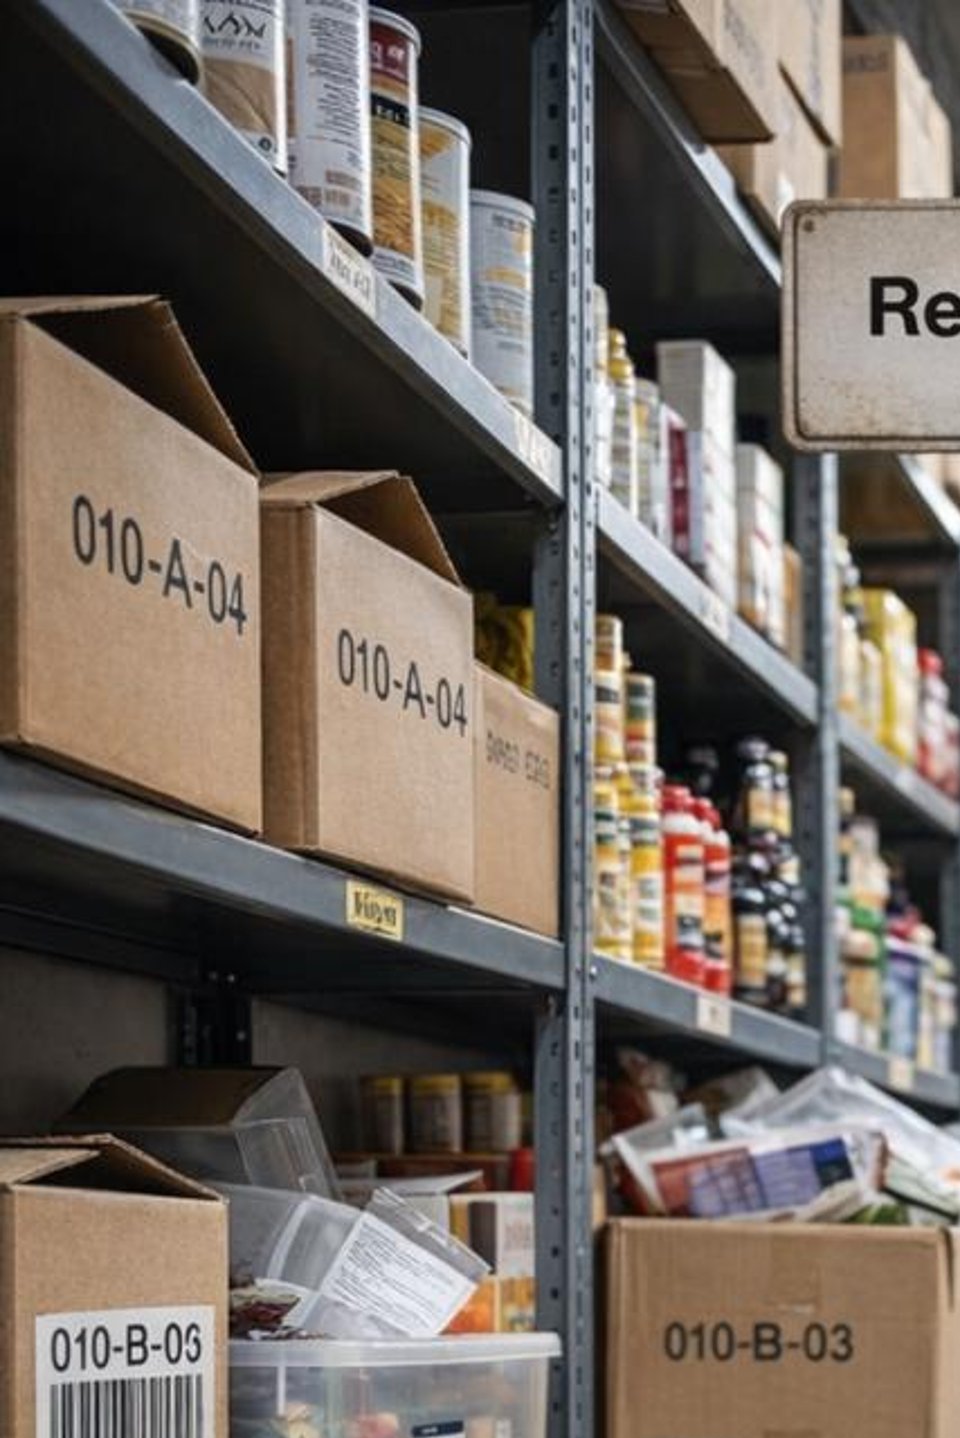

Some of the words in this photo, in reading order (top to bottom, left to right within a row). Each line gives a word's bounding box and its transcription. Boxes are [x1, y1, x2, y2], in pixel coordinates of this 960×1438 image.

[73, 494, 248, 636] 010-A-04
[338, 628, 468, 738] 010-A-04
[663, 1321, 854, 1362] 010-B-03
